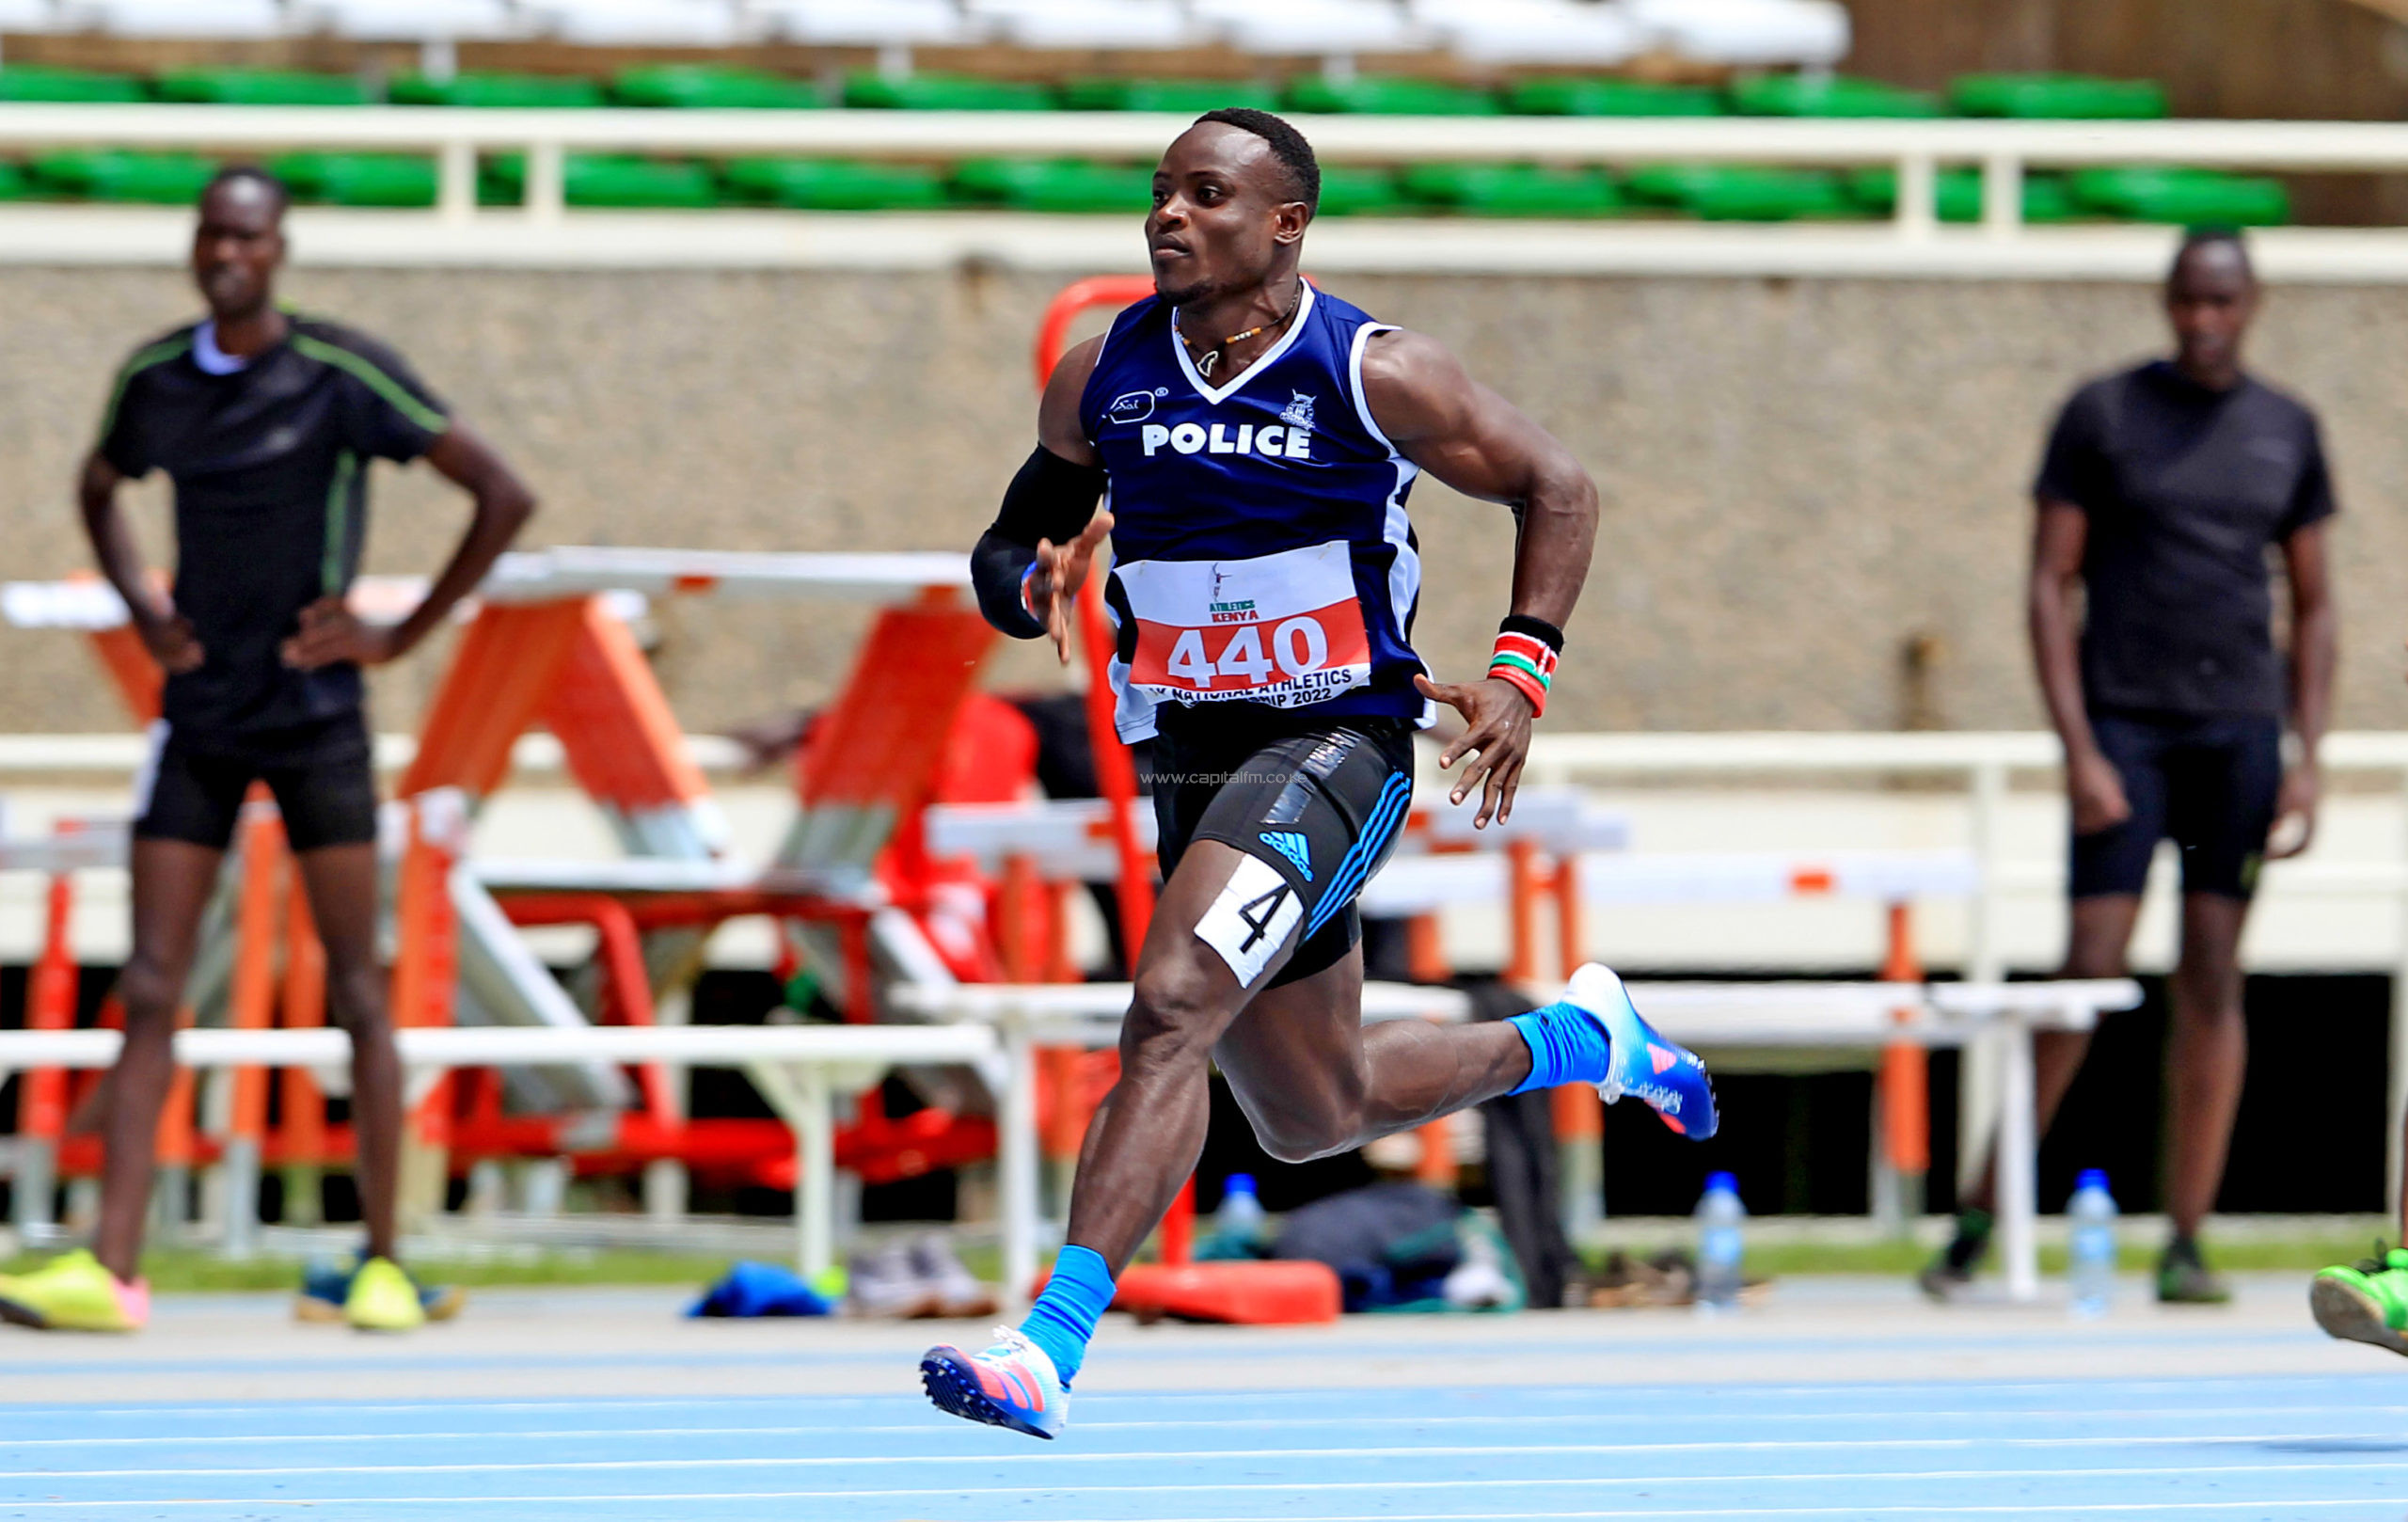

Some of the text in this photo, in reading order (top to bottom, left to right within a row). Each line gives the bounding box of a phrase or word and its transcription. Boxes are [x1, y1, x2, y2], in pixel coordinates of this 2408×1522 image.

[1142, 422, 1312, 459] POLICE
[1210, 600, 1255, 611] ATHLETICS
[1212, 610, 1259, 623] KENYA
[1167, 616, 1328, 688] 440
[1259, 669, 1352, 694] ATHLETICS
[1292, 688, 1332, 706] 2022
[1259, 832, 1314, 882] adidas
[1239, 881, 1291, 954] 4
